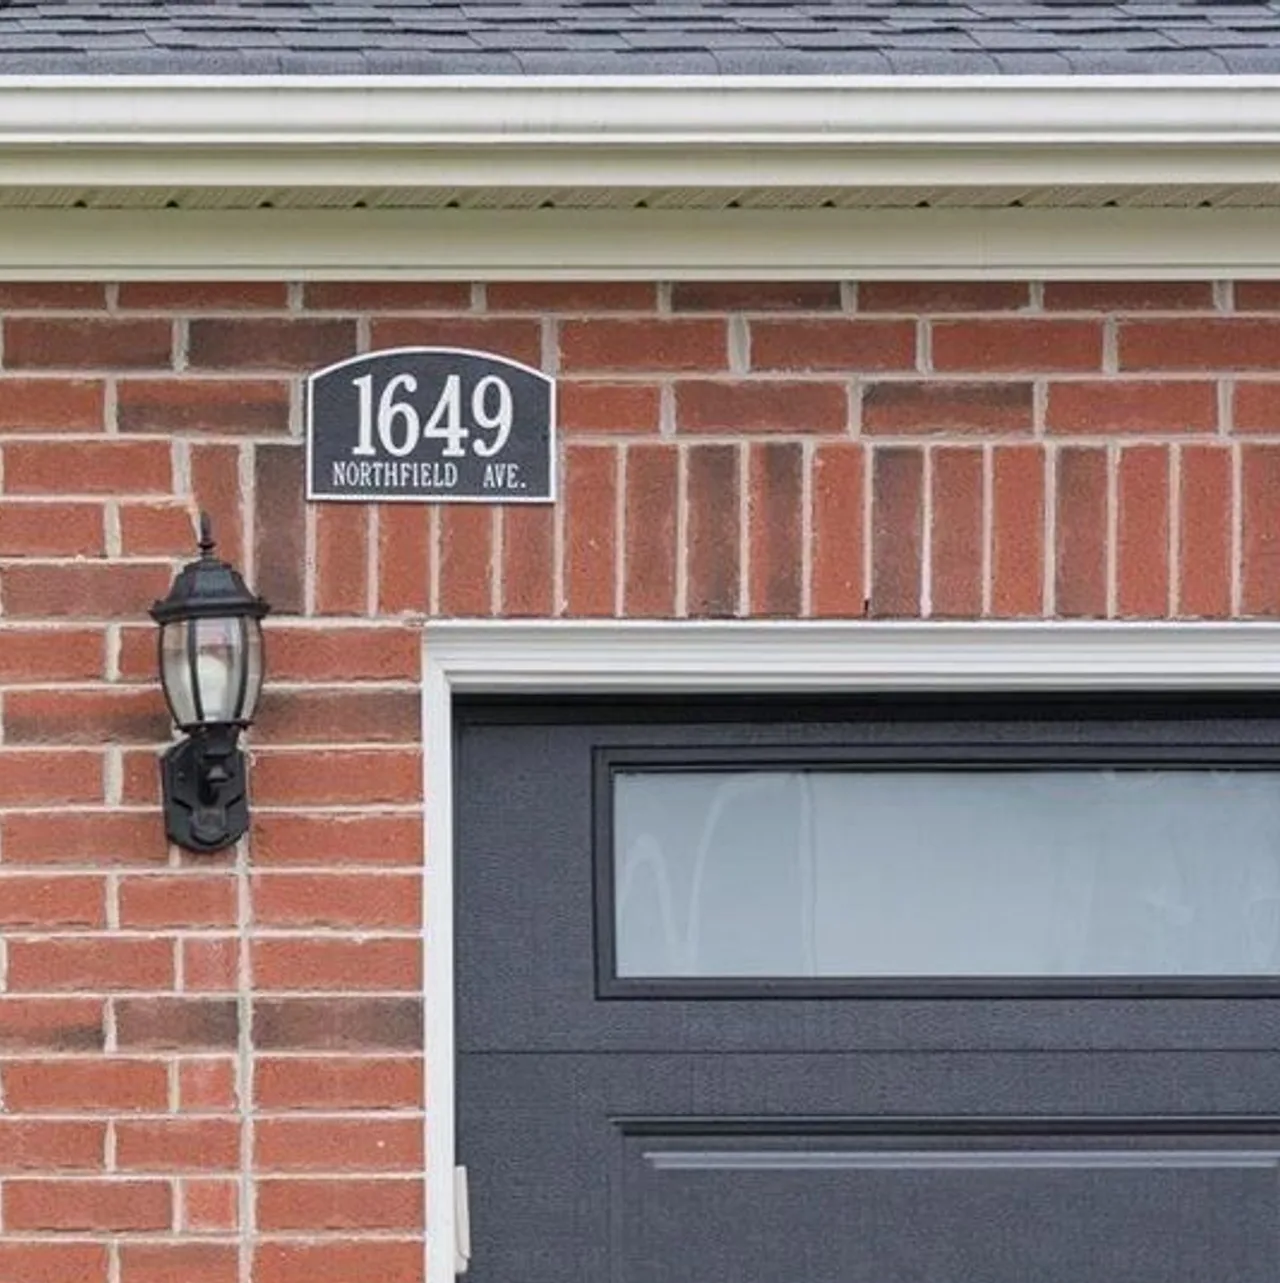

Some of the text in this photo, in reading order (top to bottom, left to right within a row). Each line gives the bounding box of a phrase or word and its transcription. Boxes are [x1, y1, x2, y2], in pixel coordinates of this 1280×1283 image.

[351, 373, 514, 457] 1649
[332, 461, 527, 489] NORTHFIELD AVE.
